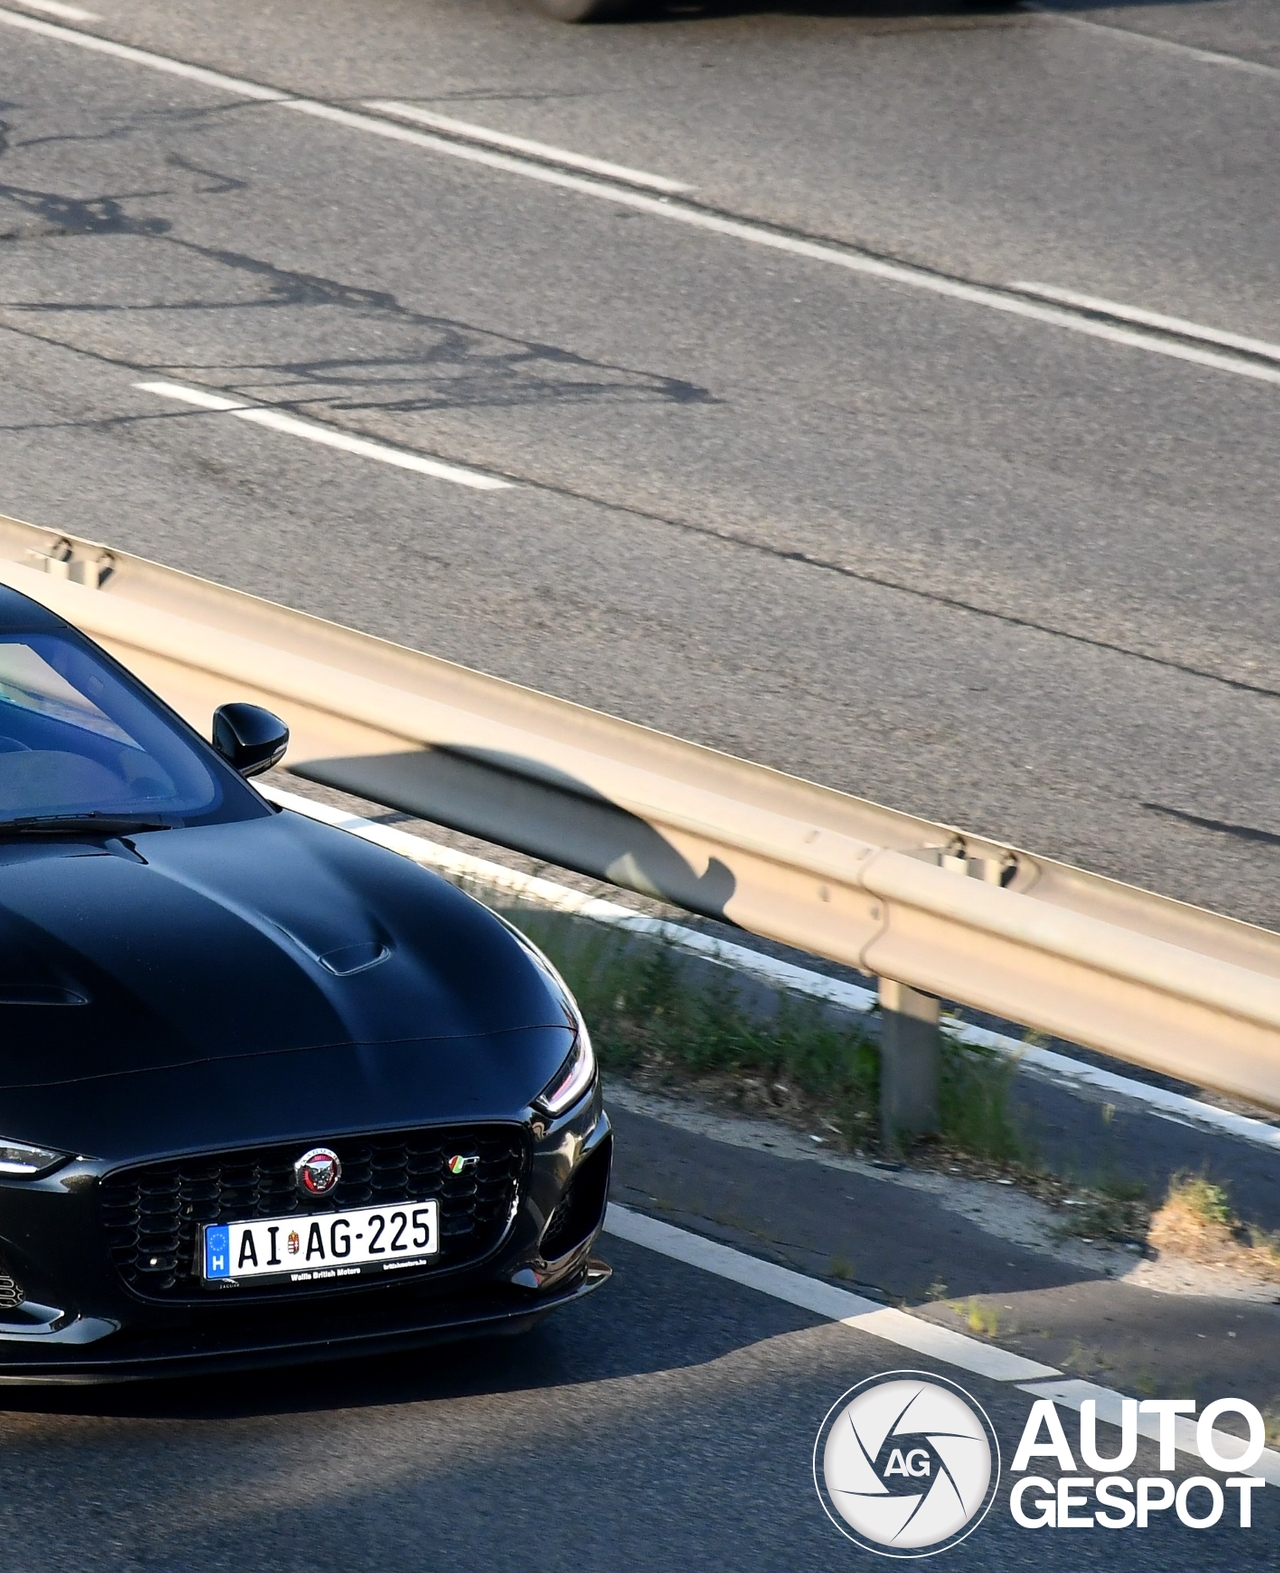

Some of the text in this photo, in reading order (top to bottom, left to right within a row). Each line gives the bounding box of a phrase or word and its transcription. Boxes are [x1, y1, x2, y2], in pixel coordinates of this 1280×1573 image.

[237, 1208, 430, 1269] AI AG-225
[212, 1254, 225, 1271] H
[312, 1270, 336, 1280] British
[337, 1267, 361, 1277] Motors
